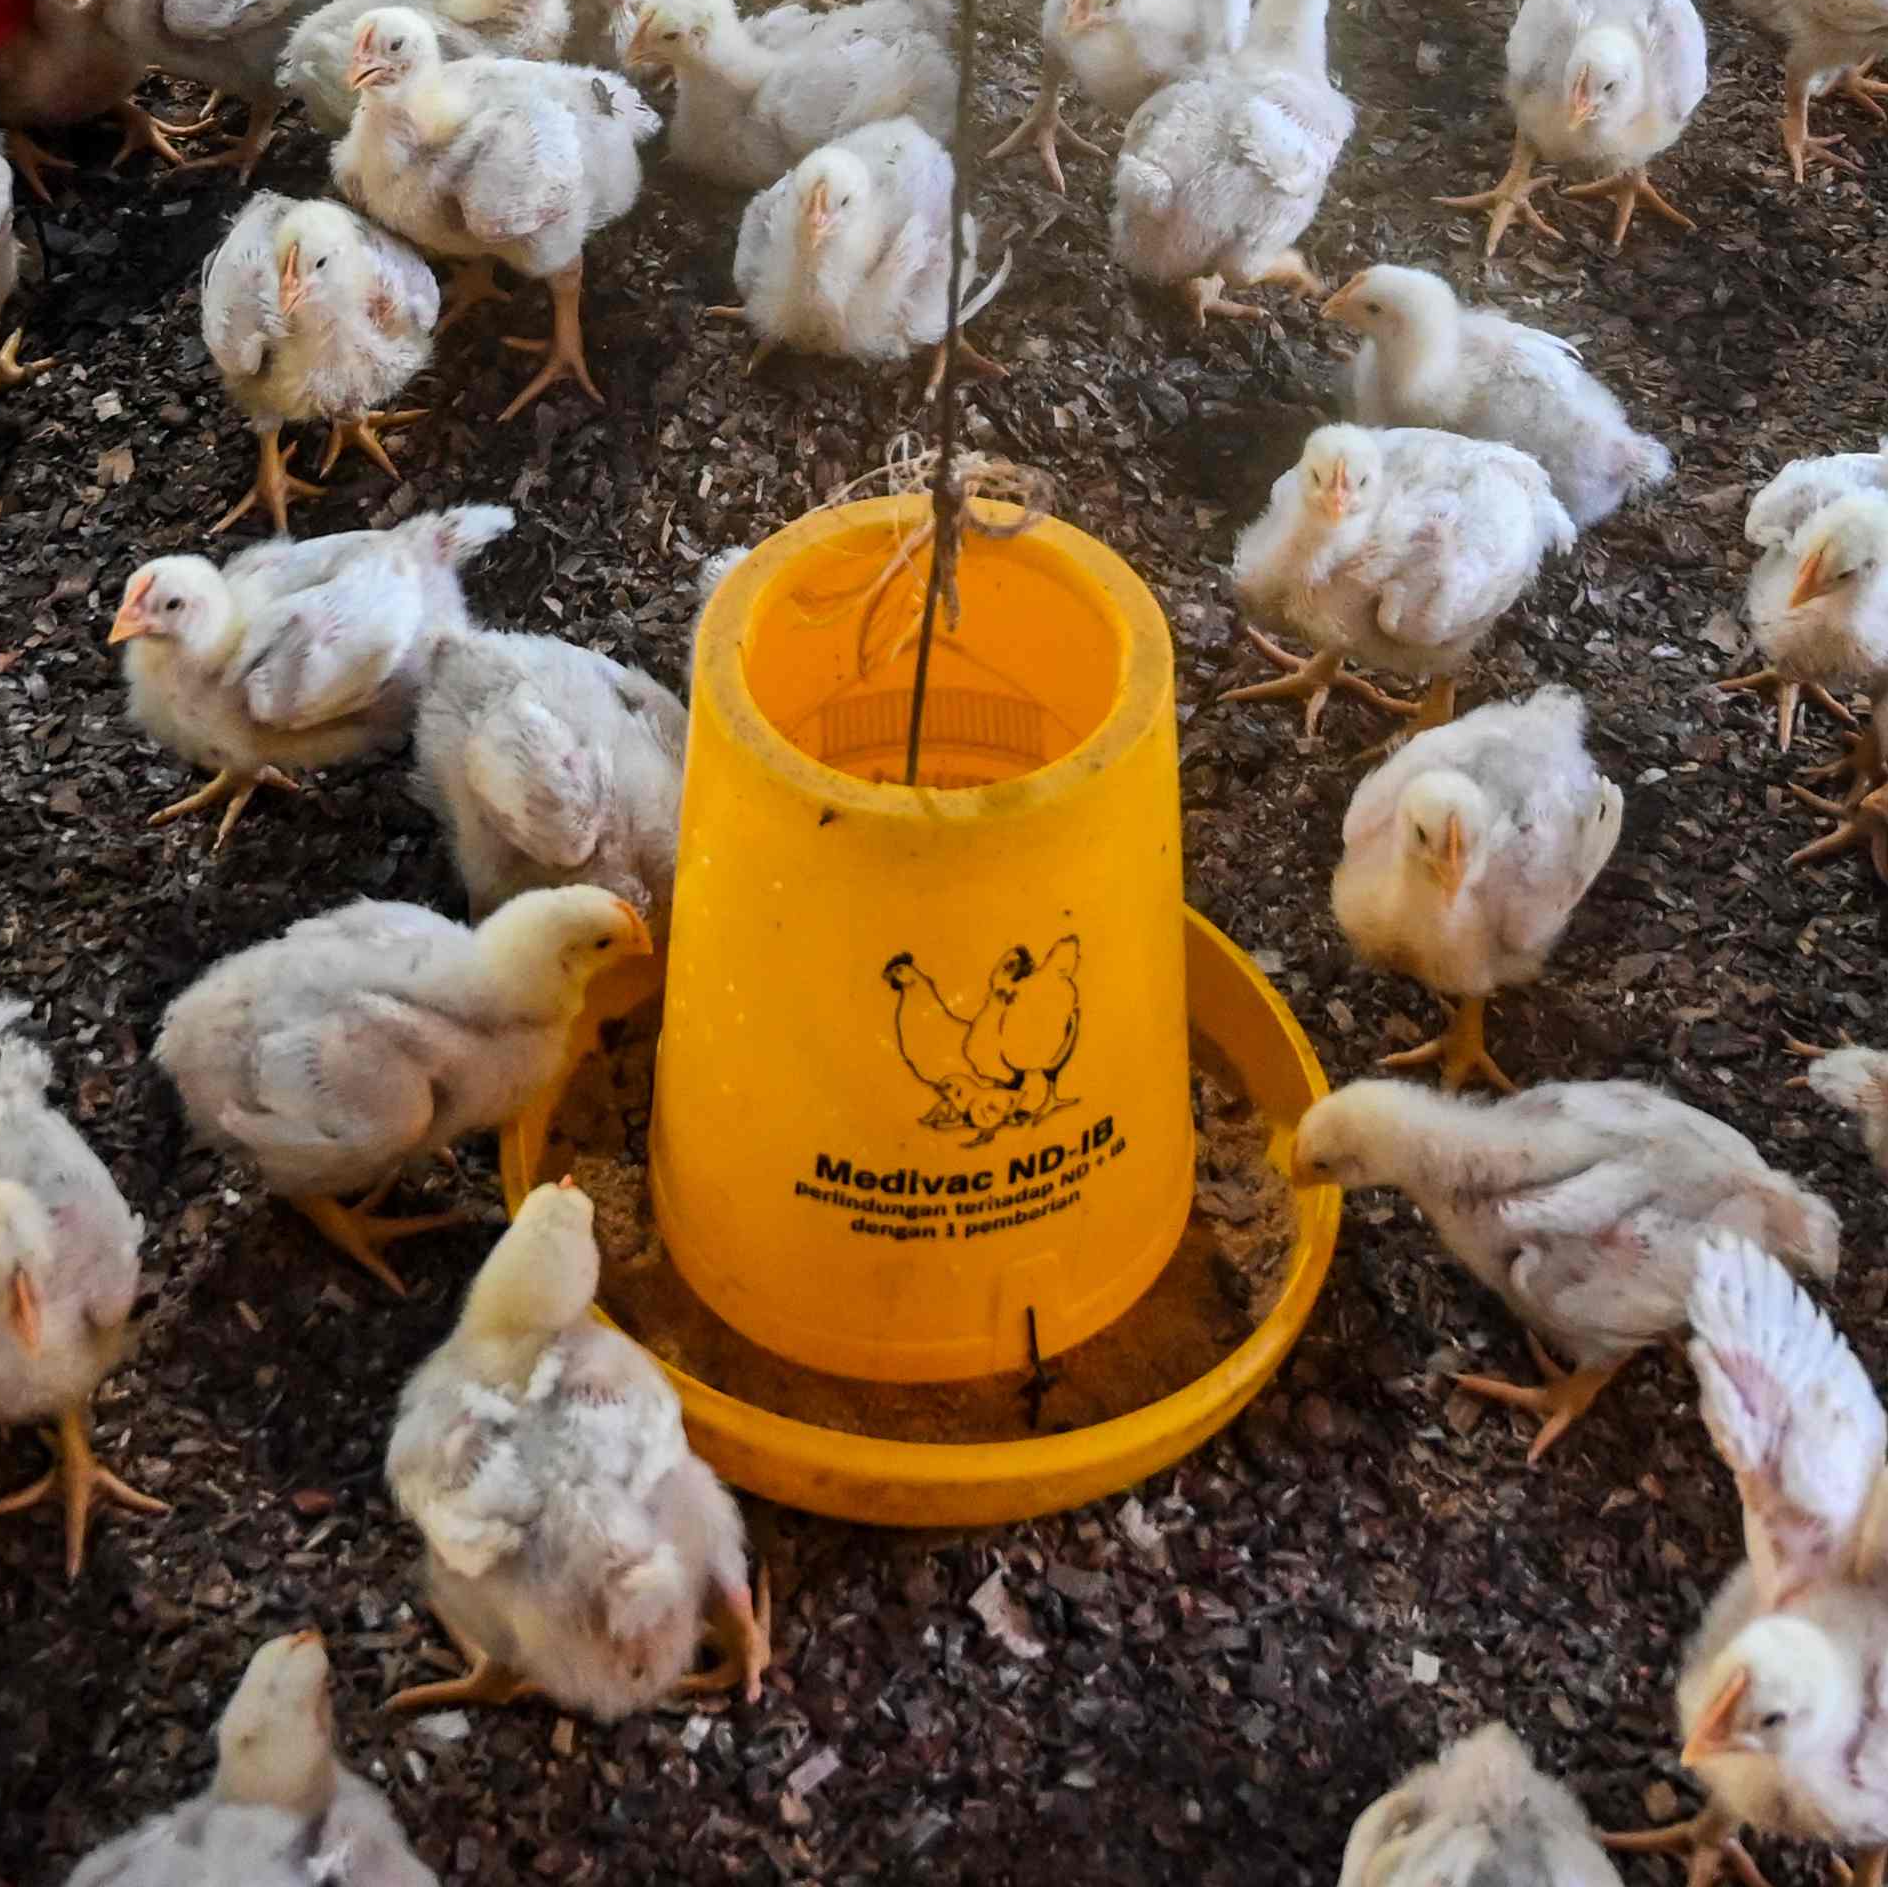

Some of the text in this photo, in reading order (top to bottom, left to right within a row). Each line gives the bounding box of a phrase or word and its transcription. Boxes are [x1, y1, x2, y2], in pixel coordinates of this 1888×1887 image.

[816, 1115, 1114, 1195] Medivac ND-IB
[795, 1181, 947, 1220] perlindungan
[955, 1181, 1054, 1216] terhadap
[1060, 1162, 1090, 1187] ND
[850, 1190, 1081, 1240] dengan 1 pemberian
